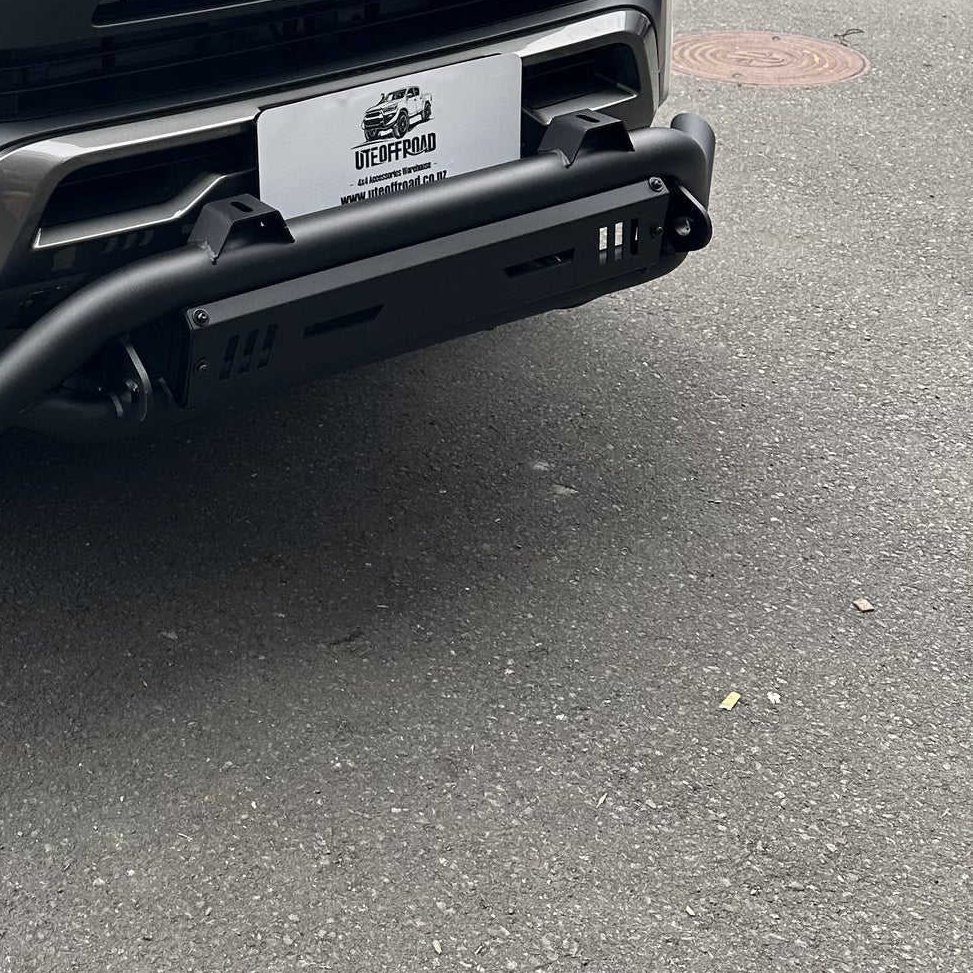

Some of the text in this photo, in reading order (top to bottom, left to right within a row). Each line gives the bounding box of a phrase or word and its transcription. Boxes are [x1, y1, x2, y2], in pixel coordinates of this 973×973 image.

[355, 132, 437, 170] UTEOFFROAD
[340, 170, 447, 205] wwwuteoffroadconz
[357, 162, 432, 187] 4x4 Accessories Warehouse
